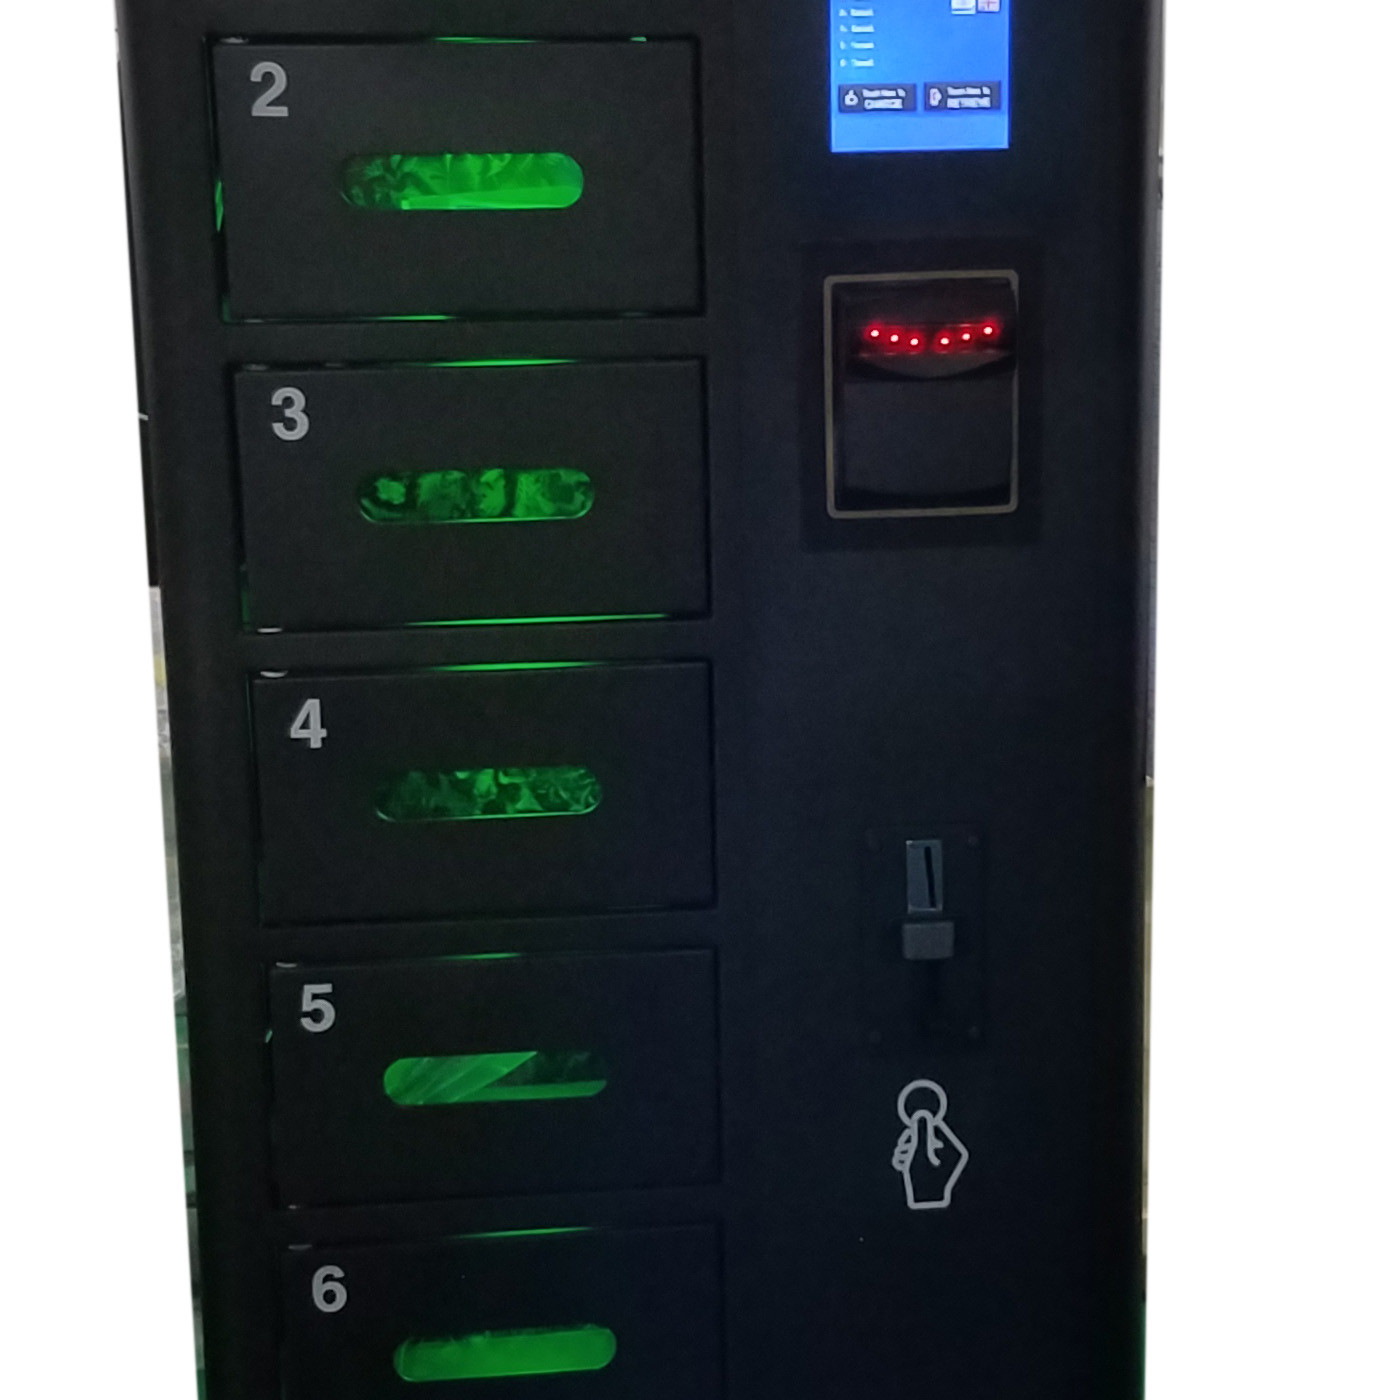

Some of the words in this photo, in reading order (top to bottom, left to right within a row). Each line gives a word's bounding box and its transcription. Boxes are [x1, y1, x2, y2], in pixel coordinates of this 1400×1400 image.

[250, 61, 289, 117] 2
[271, 386, 309, 441] 3
[289, 698, 327, 750] 4
[300, 983, 336, 1032] 5
[311, 1265, 348, 1313] 6
